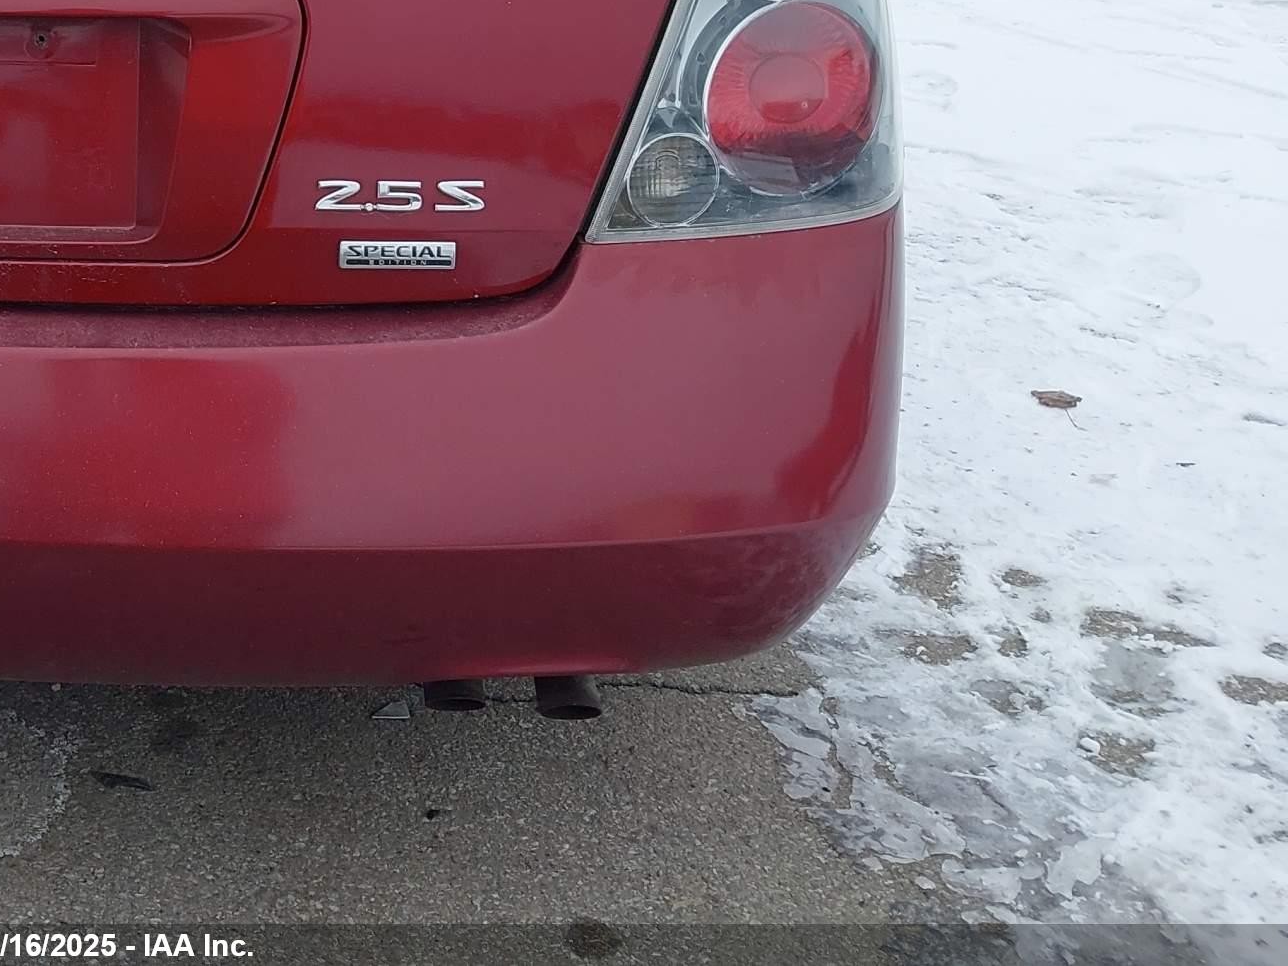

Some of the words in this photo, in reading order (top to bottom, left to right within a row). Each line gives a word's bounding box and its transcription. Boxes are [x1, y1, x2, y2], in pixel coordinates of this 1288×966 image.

[314, 180, 423, 211] 2.5
[434, 180, 486, 211] S
[346, 245, 451, 258] SPECIAL
[369, 258, 428, 266] EDITION
